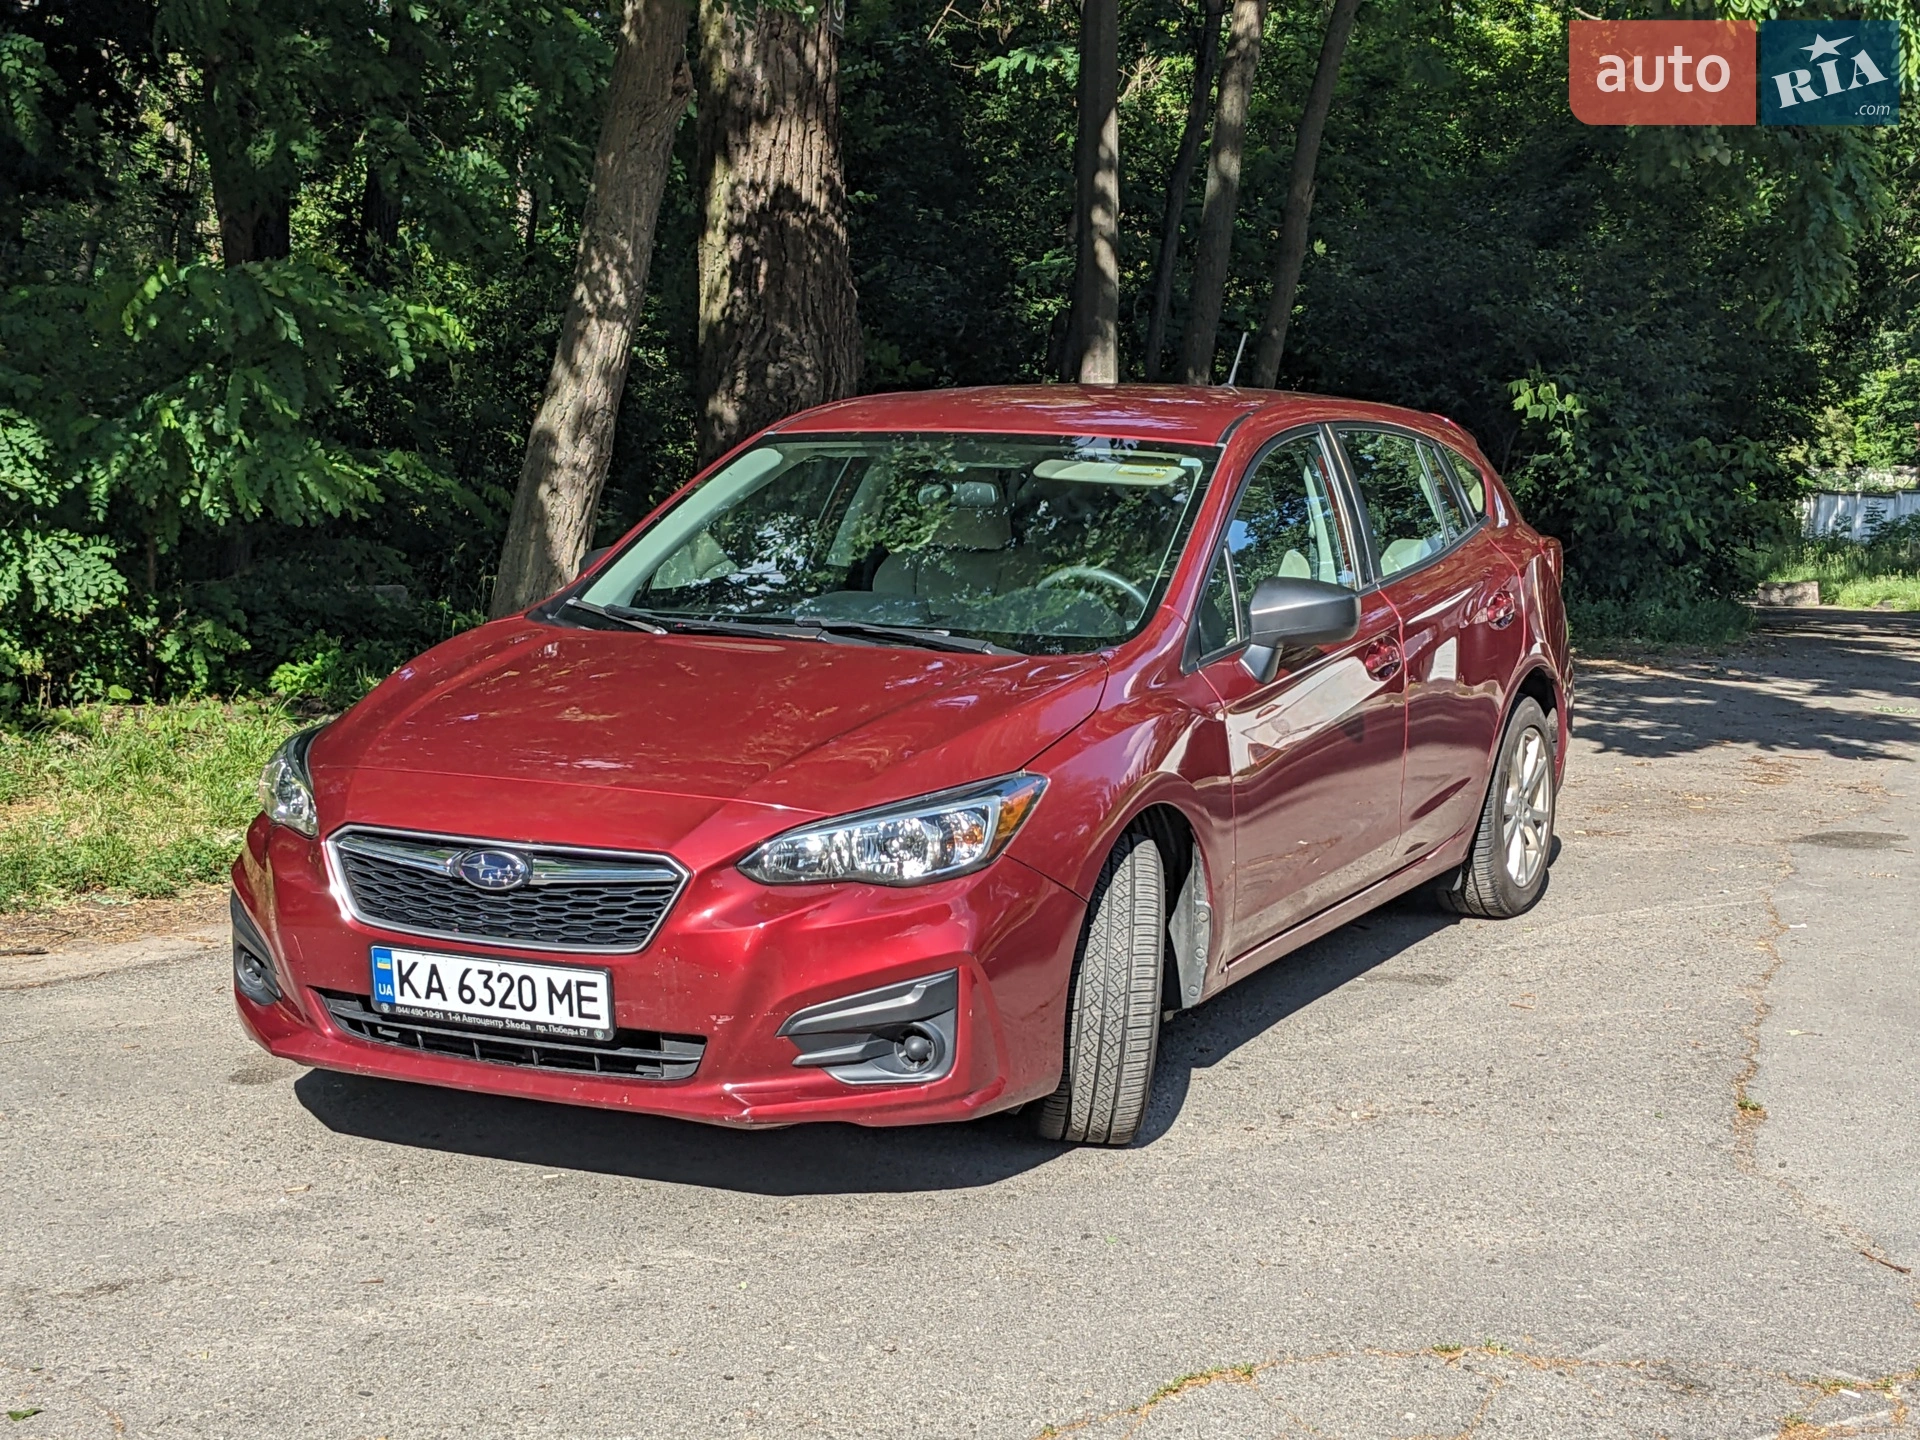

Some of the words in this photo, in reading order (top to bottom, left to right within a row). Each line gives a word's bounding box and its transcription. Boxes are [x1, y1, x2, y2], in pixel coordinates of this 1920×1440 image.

[378, 982, 394, 997] UA
[396, 959, 448, 1002] KA
[457, 967, 538, 1013] 6320
[546, 976, 601, 1021] ME
[411, 1008, 445, 1020] 490-10-91
[447, 1011, 461, 1022] 1-й
[462, 1013, 504, 1029] Автоцентр
[579, 1027, 589, 1037] 67
